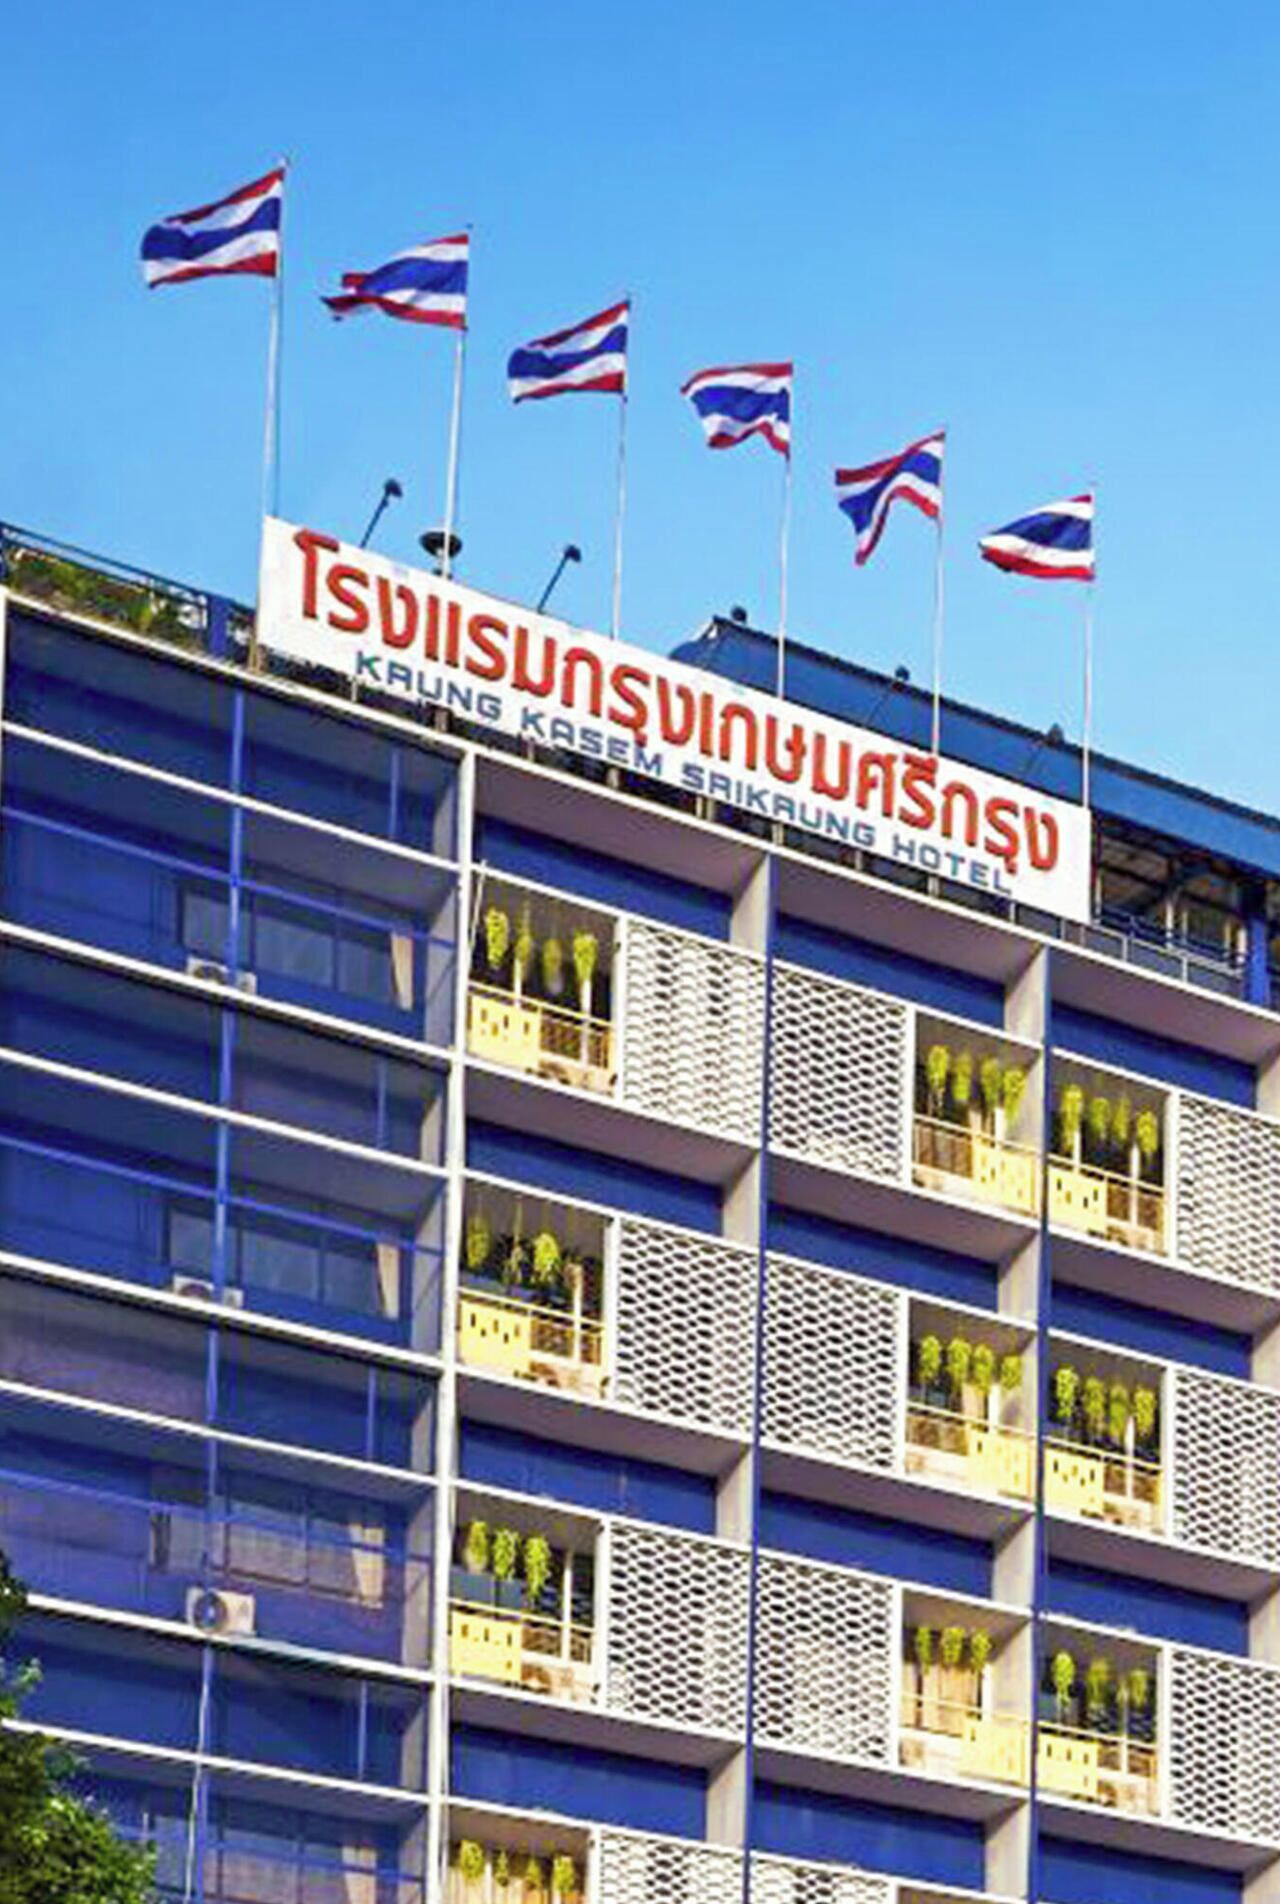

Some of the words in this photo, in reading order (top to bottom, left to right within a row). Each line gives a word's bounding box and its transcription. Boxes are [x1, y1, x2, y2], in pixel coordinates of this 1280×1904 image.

[295, 529, 1060, 874] โรงแรมกรุงเกษมศรีกรุง
[356, 650, 503, 722] KRUNG
[520, 706, 664, 777] KASEM
[680, 762, 878, 848] SRIKRUNG
[892, 832, 1014, 896] HOTEL
